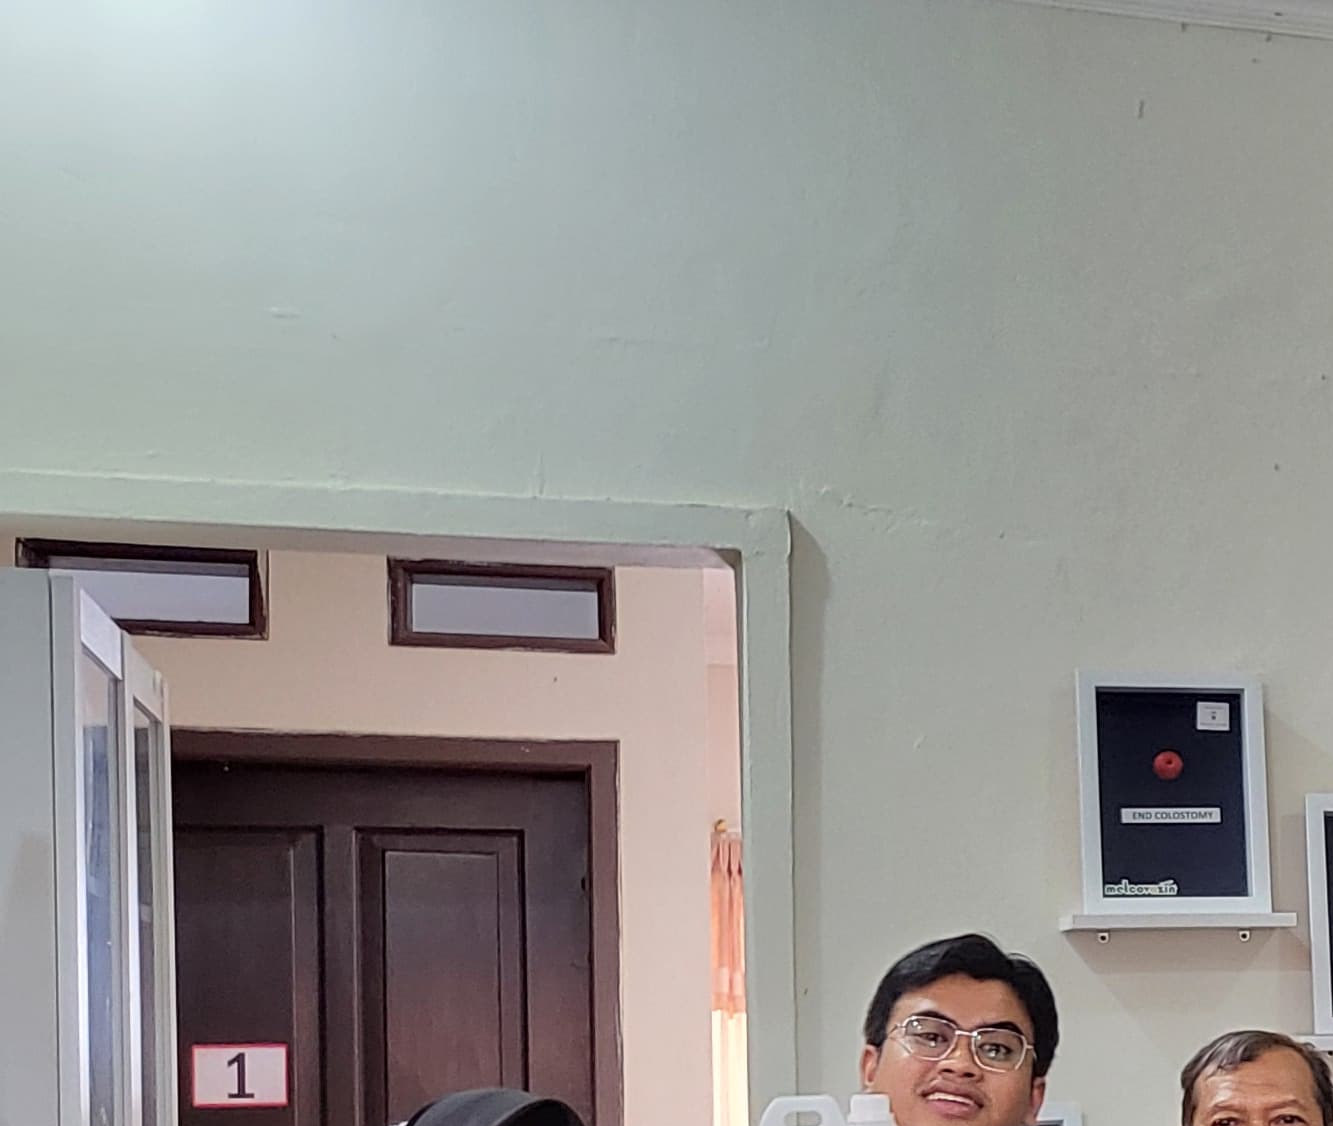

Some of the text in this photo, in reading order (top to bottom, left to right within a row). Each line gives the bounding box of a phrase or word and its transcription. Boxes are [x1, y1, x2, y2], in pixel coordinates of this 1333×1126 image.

[1132, 811, 1213, 820] END COLOSTOMY
[227, 1052, 255, 1099] 1
